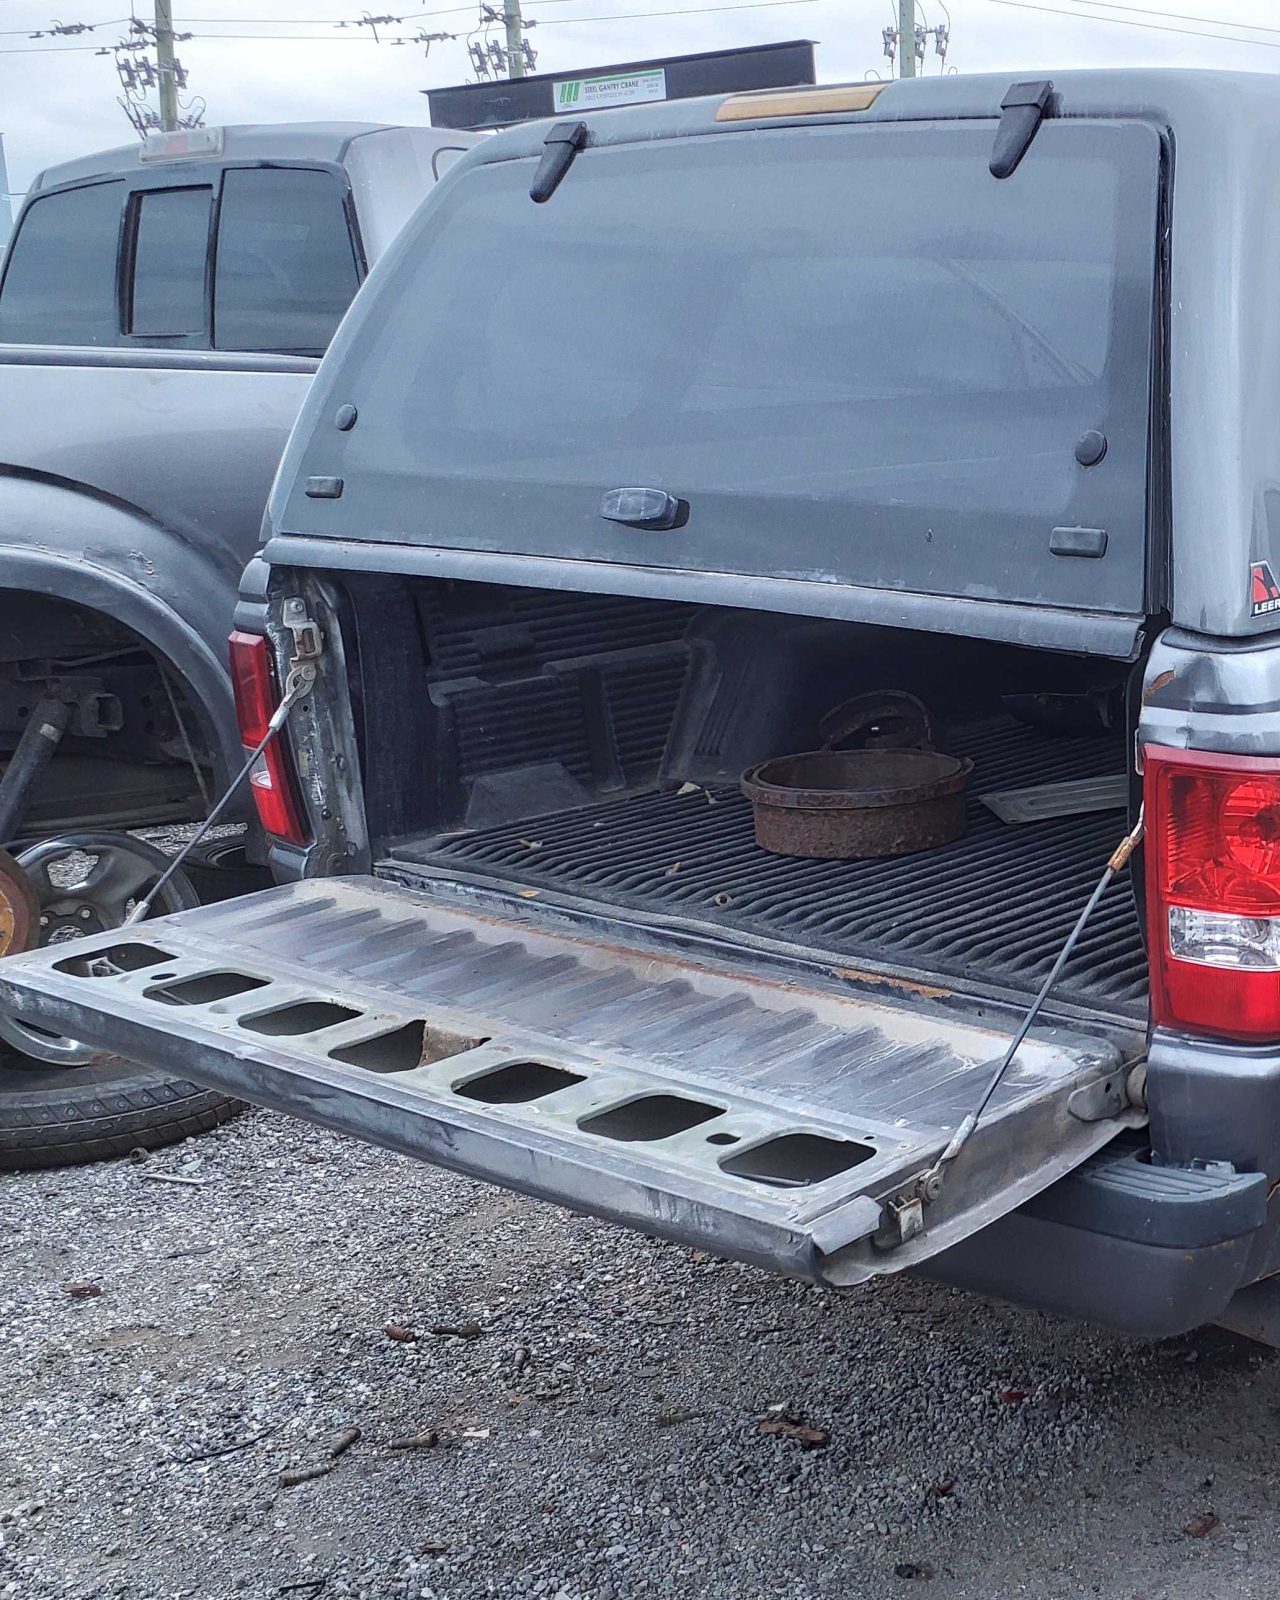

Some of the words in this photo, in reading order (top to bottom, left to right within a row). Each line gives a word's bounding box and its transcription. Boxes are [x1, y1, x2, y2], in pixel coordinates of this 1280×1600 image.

[584, 84, 598, 94] STEEL
[599, 82, 620, 92] GANTRY
[621, 80, 640, 89] CRANE
